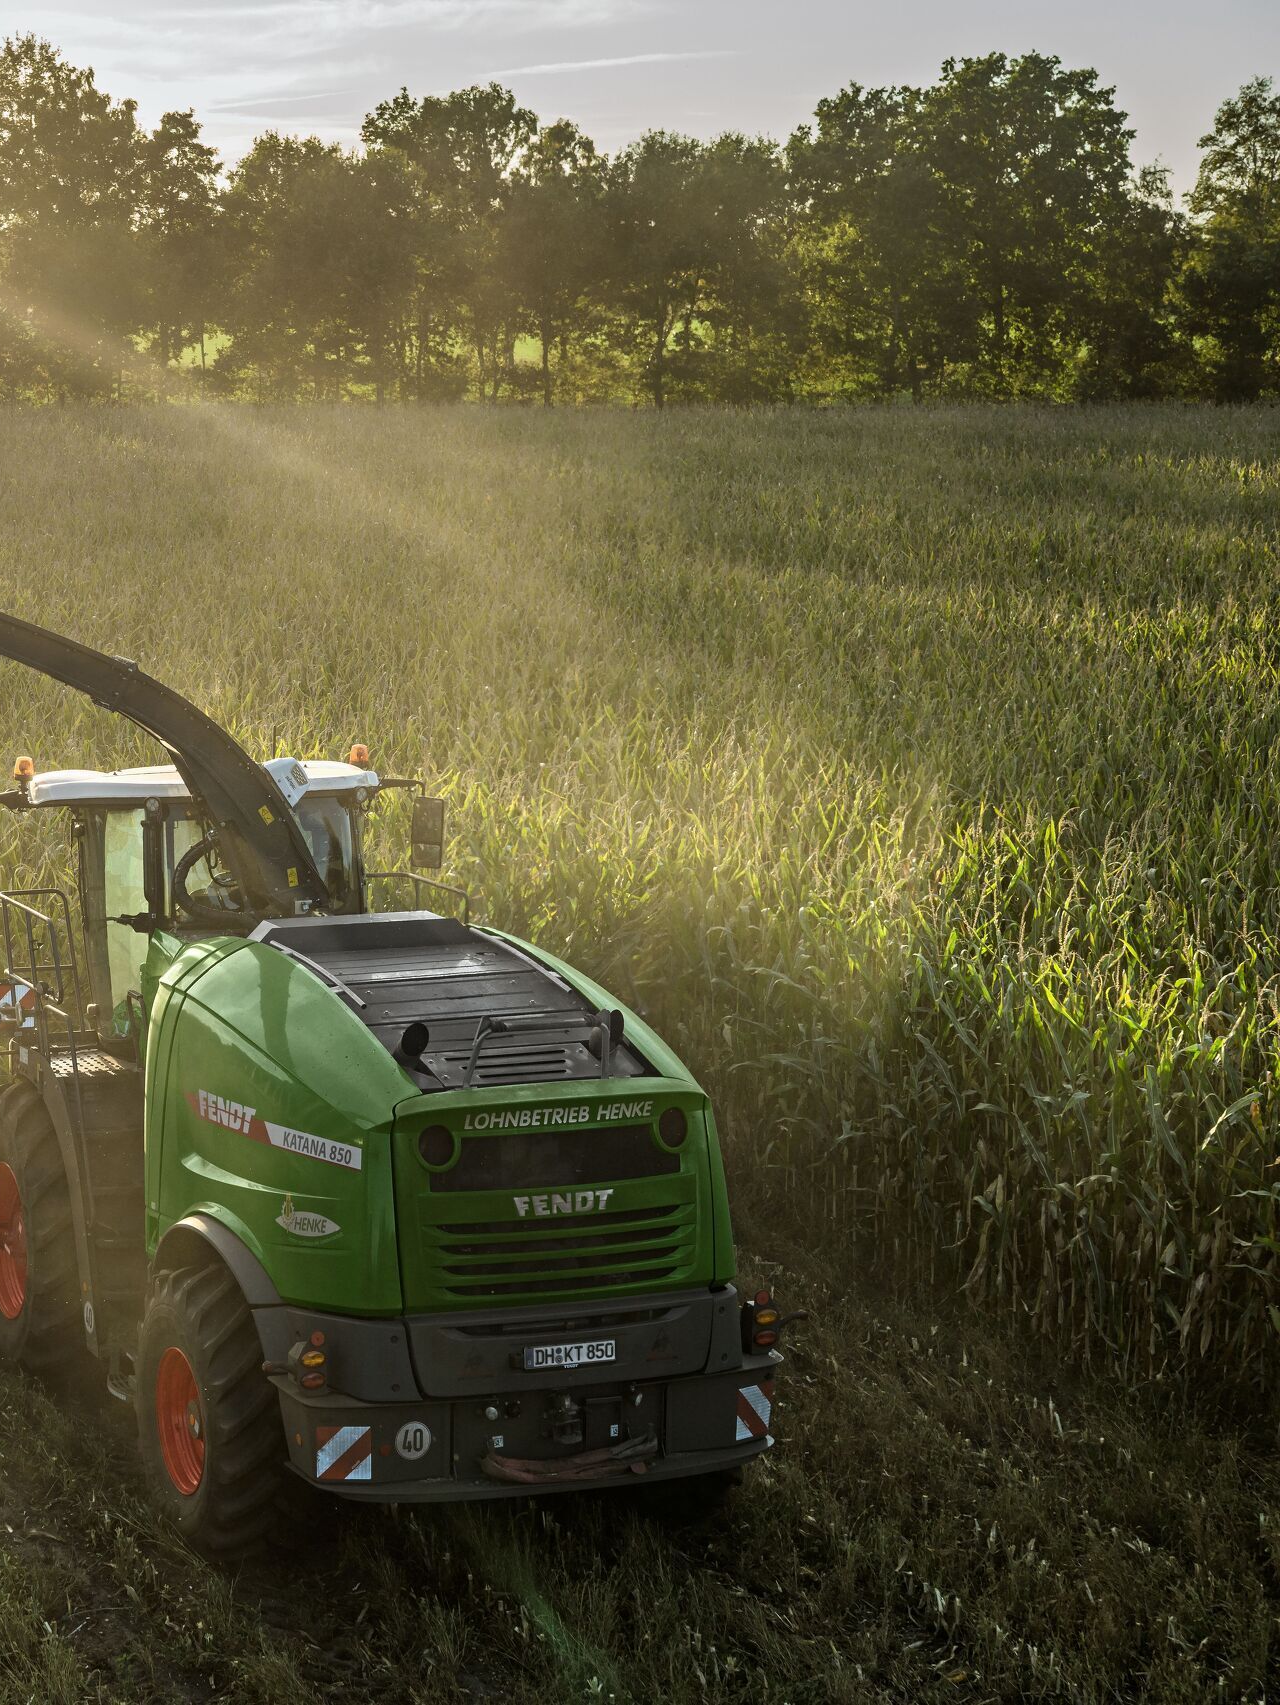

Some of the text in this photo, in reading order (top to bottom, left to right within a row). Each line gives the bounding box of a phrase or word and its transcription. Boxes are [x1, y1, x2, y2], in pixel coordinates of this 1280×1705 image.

[198, 1088, 352, 1165] FENDT KATANA 850
[464, 1101, 653, 1130] LOHNBETRIEB HENKE
[513, 1189, 614, 1217] FENDT
[293, 1216, 328, 1233] HENKE
[86, 1305, 93, 1328] 40
[534, 1342, 614, 1366] DH KT 850
[402, 1428, 424, 1453] 40
